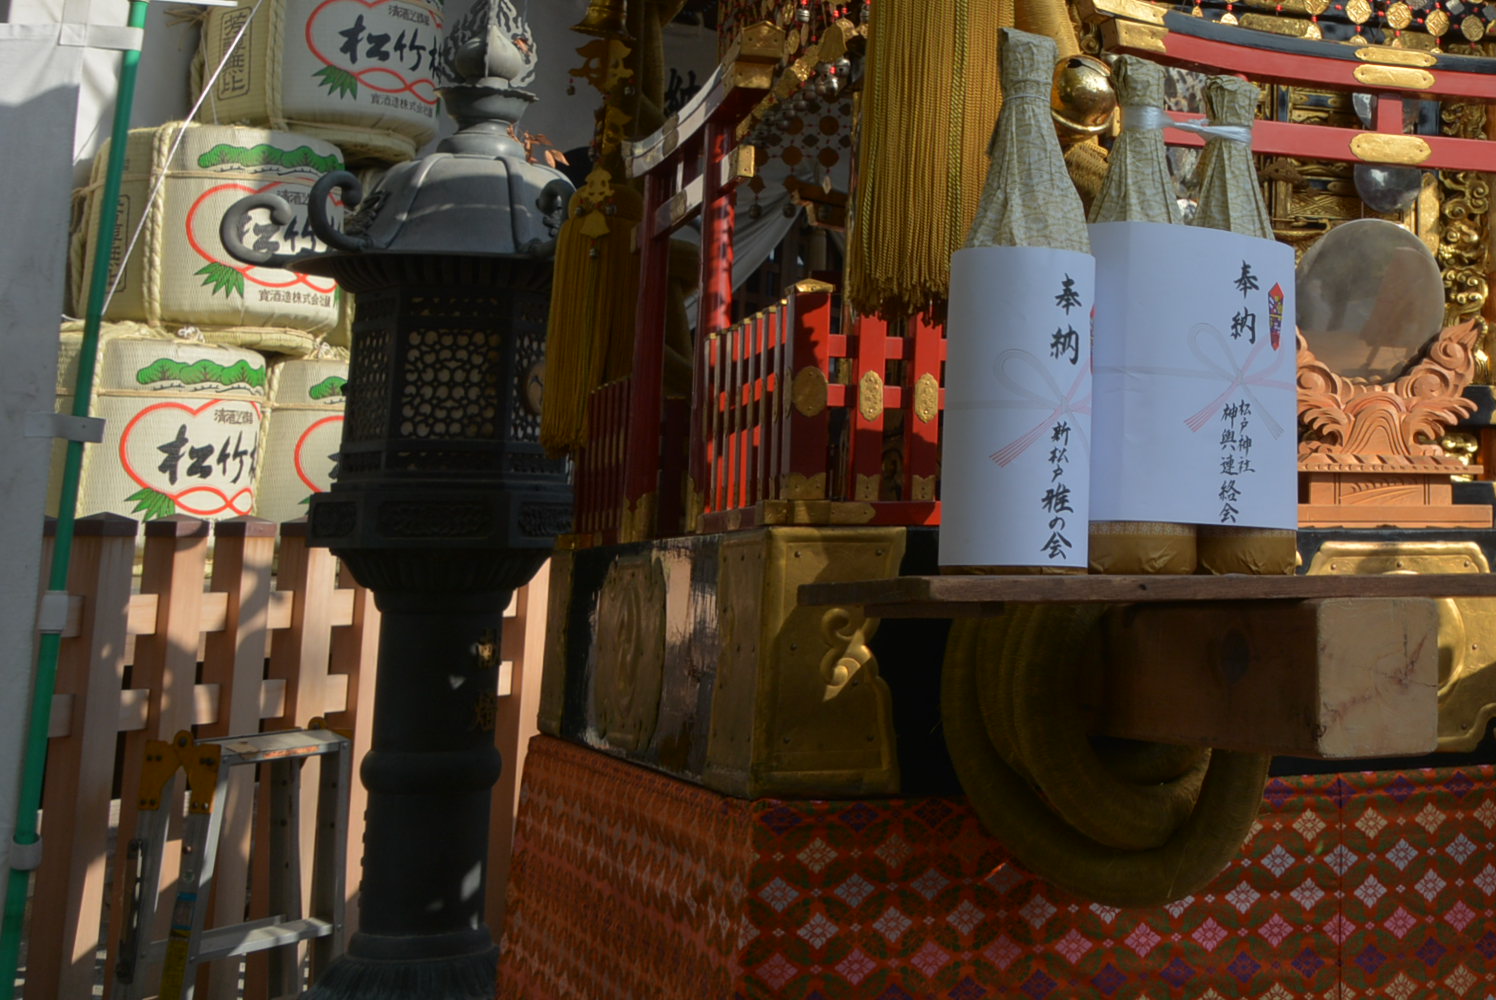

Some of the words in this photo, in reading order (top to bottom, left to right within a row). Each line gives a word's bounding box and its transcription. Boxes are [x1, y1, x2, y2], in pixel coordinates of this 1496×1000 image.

[1050, 273, 1083, 365] 奉納
[1231, 260, 1260, 344] 奉納
[157, 424, 257, 486] 松竹
[1238, 400, 1255, 474] 松戸神社
[1042, 421, 1074, 559] 新松戸雅の会
